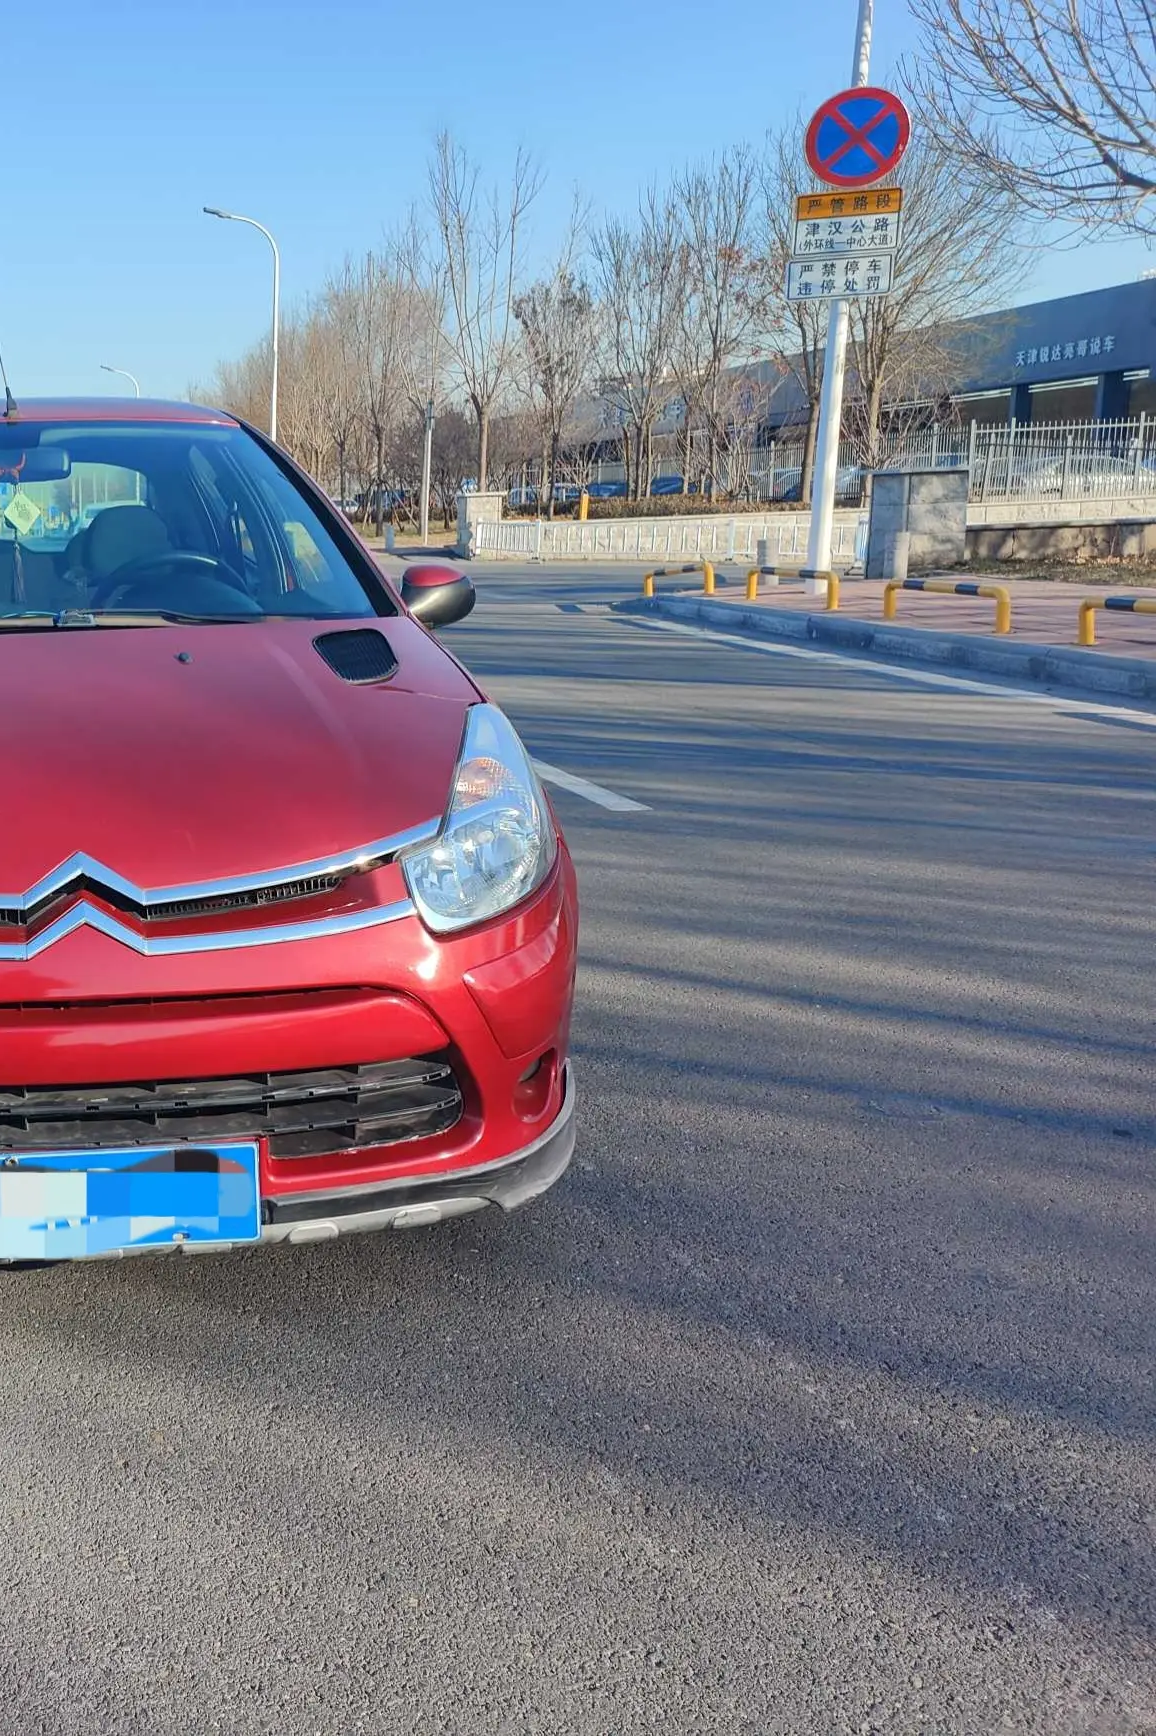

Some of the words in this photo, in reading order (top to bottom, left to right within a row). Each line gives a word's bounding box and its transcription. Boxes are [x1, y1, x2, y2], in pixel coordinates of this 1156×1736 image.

[807, 194, 891, 213] 严管路段
[805, 217, 890, 237] 津汉公路
[799, 258, 882, 279] 严禁停车
[797, 276, 881, 296] 违停处罚
